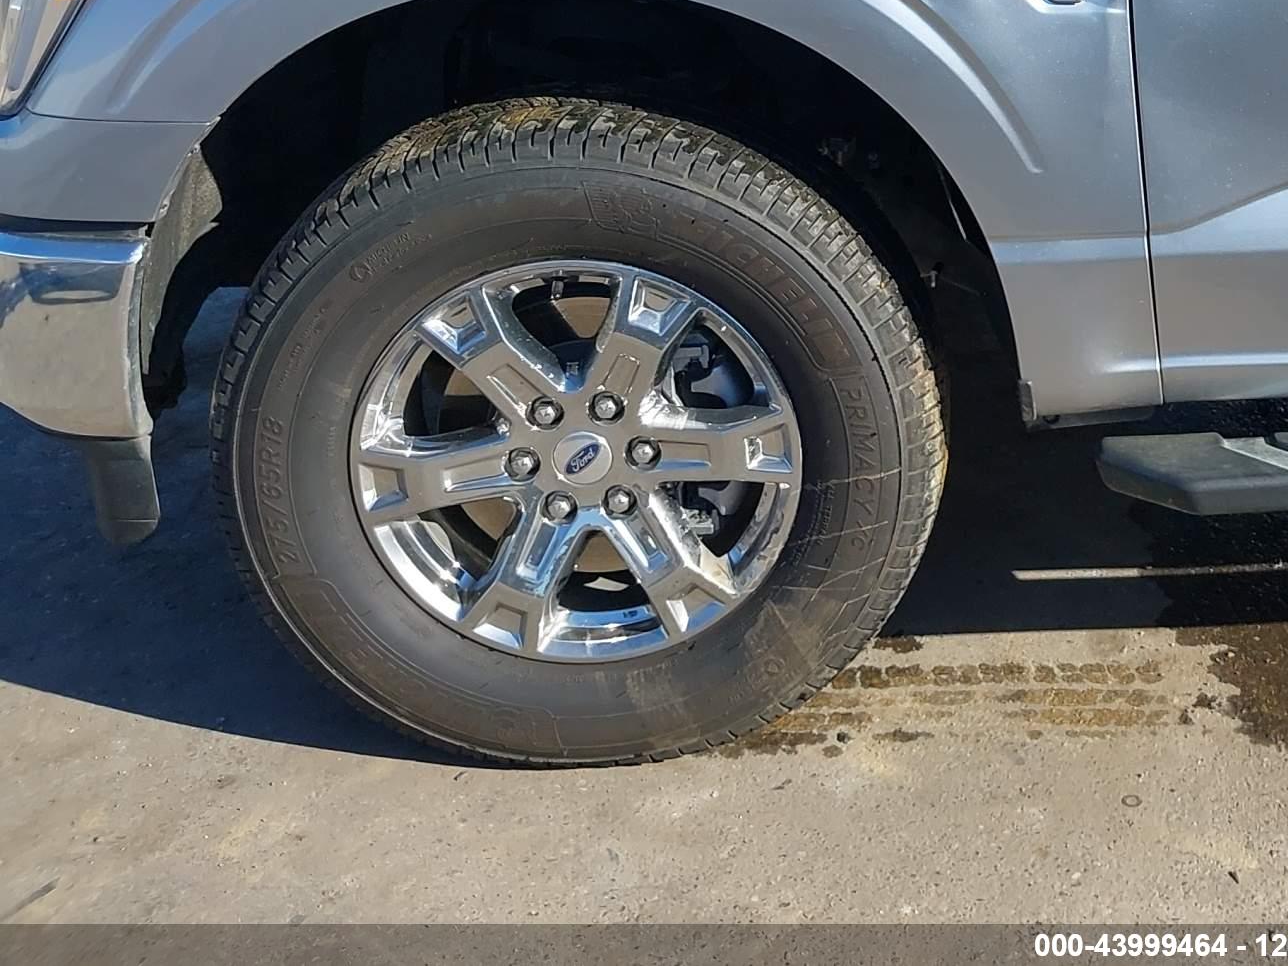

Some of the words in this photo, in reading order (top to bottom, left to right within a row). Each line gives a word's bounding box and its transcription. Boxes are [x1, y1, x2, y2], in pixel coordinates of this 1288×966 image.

[258, 416, 297, 564] 275/65R18
[570, 447, 595, 472] Ford
[840, 387, 878, 516] PRIMACY
